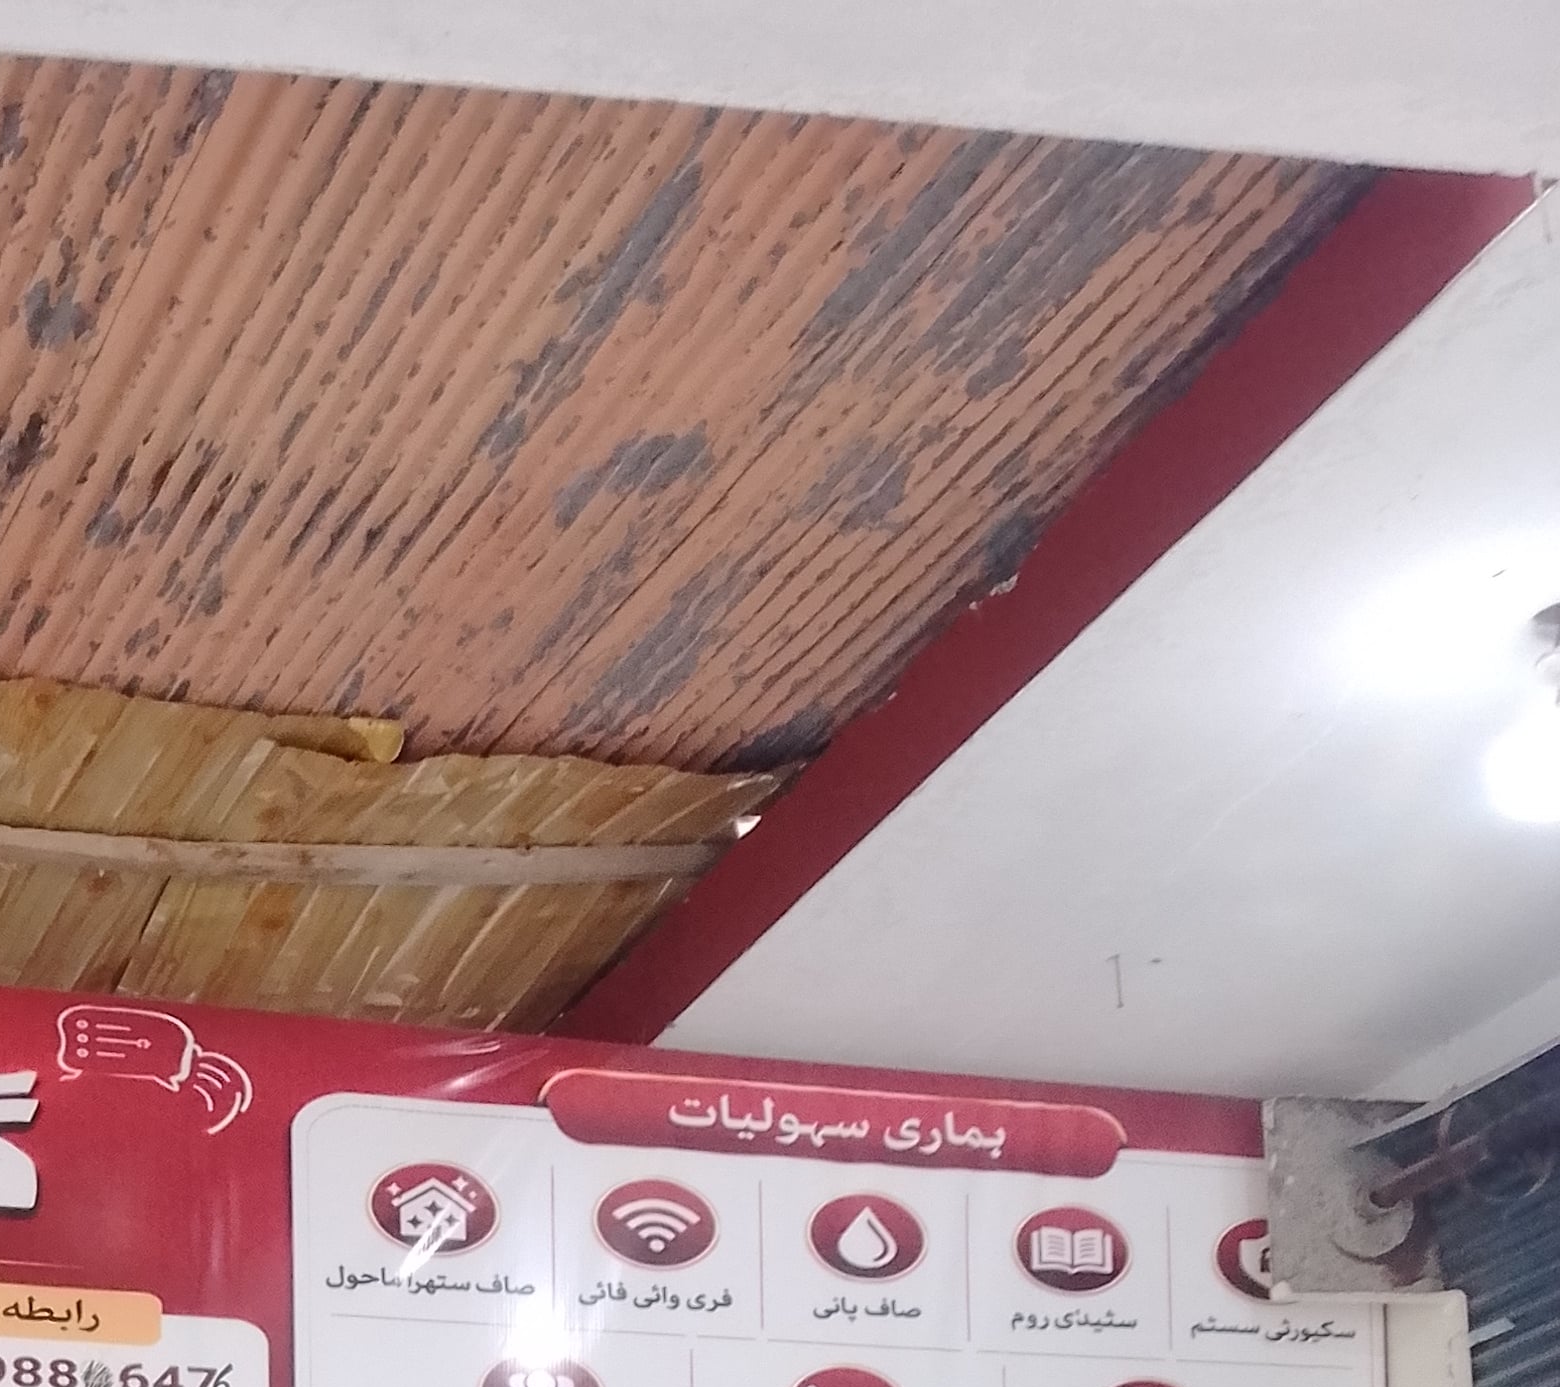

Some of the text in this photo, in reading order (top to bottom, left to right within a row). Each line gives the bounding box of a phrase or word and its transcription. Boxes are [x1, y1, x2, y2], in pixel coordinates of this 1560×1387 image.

[669, 1093, 1007, 1159] ہماری سہولیات
[475, 1270, 536, 1296] صاف
[577, 1279, 733, 1312] فری وائی فائی
[2, 1292, 102, 1333] رابطہ
[863, 1296, 922, 1320] صاف
[1011, 1310, 1050, 1330] روم
